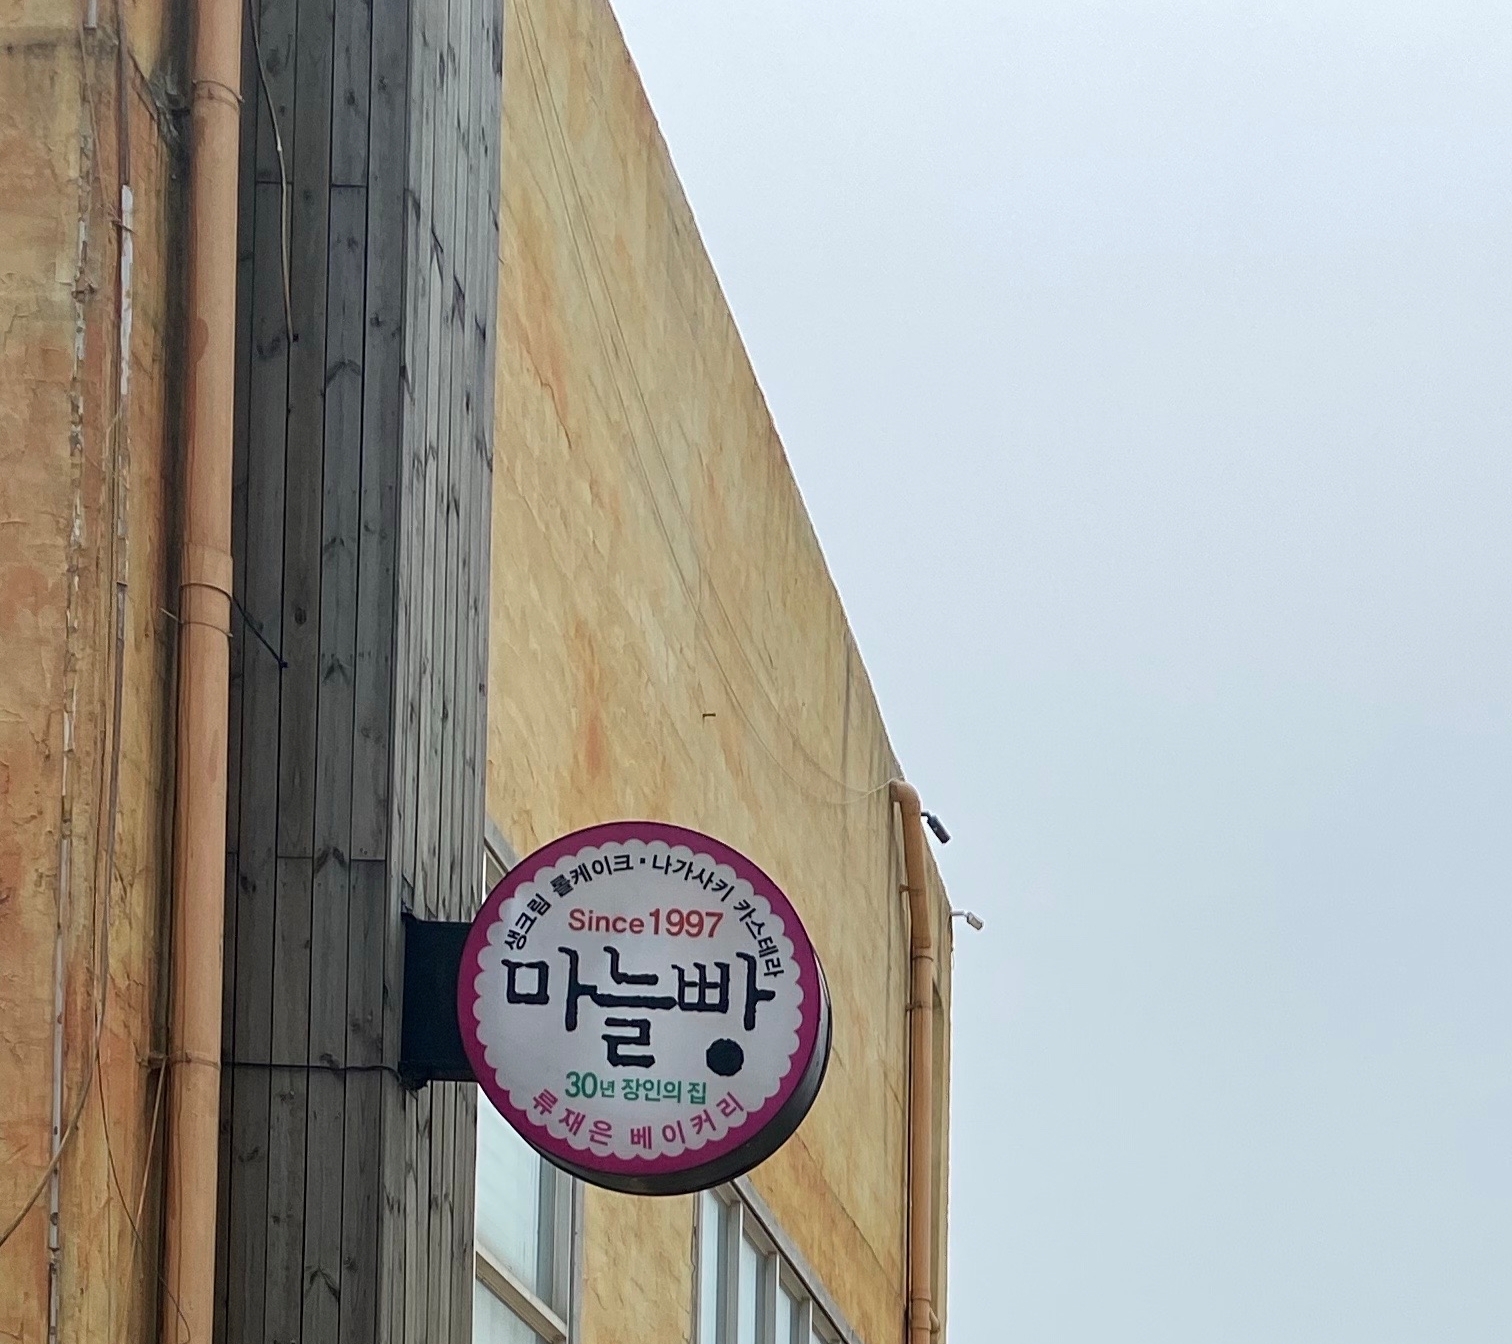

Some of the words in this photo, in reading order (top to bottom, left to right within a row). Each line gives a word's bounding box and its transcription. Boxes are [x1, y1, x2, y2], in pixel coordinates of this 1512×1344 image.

[504, 893, 552, 950] 생크림
[733, 899, 785, 978] 카스테라
[501, 945, 772, 1077] 마늘빵
[532, 1088, 613, 1146] 류재은
[630, 1091, 744, 1150] 베이커리
[565, 1071, 615, 1098] 30년
[621, 1078, 682, 1103] 장인의
[687, 1081, 707, 1105] 집
